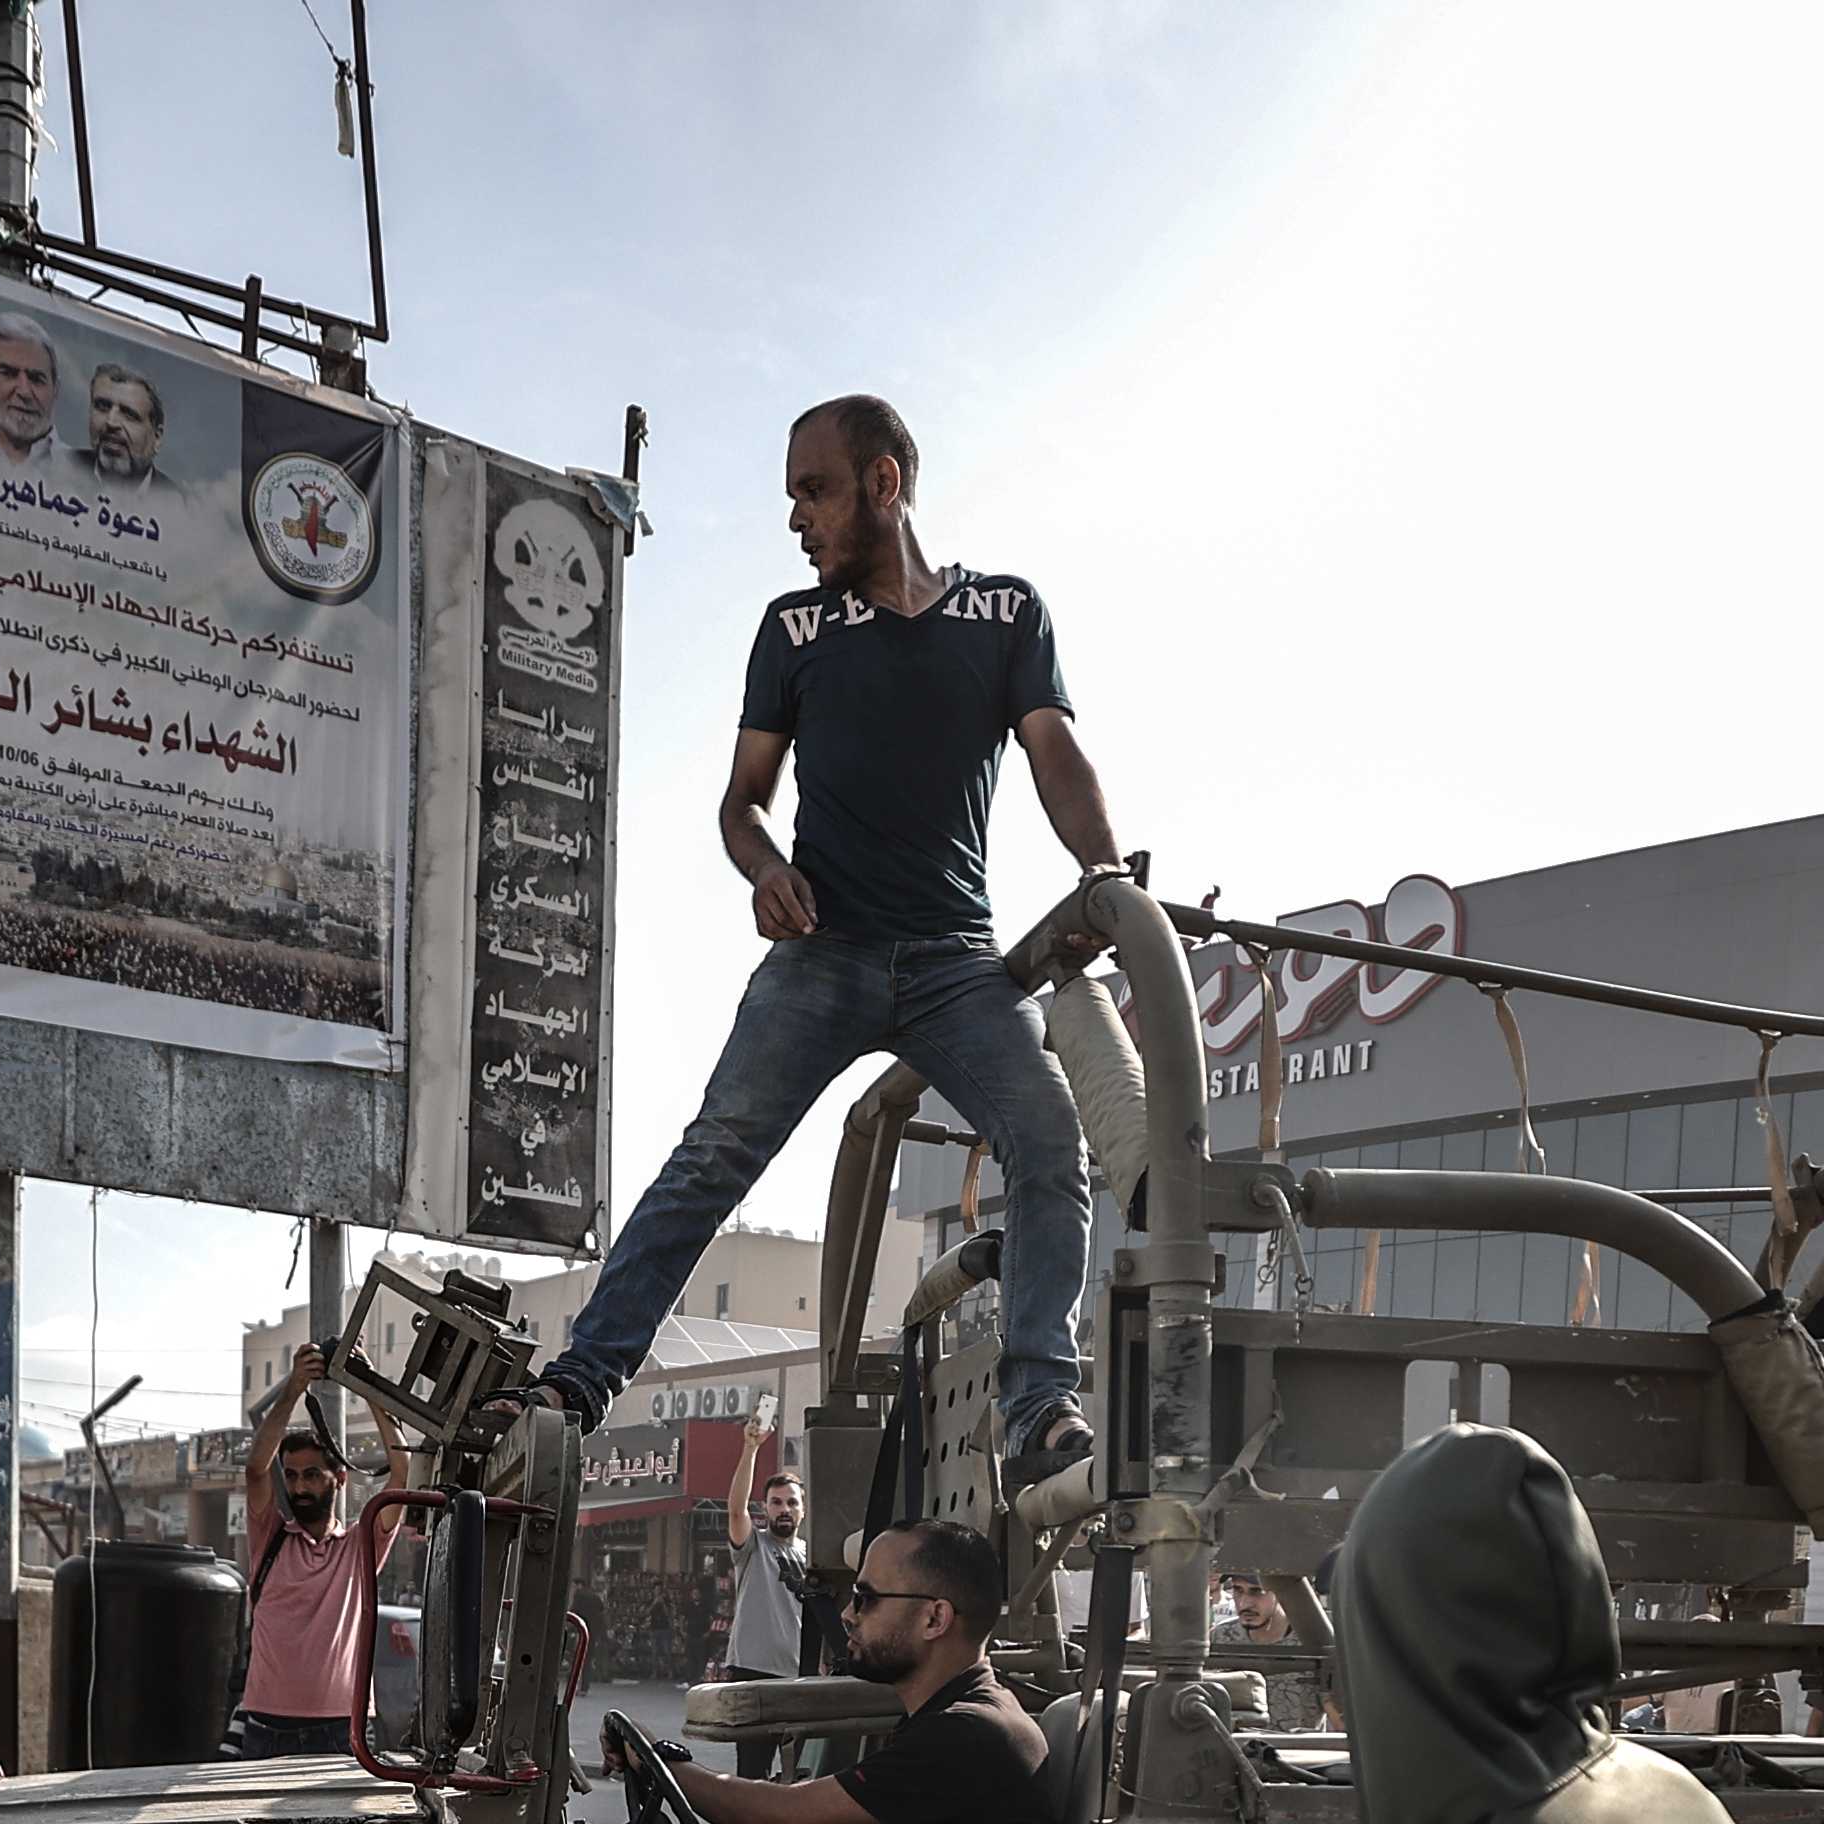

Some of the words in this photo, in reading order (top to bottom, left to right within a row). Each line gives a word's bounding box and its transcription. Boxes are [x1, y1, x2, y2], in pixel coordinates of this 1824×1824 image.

[96, 493, 160, 542] دعوة
[52, 536, 111, 565] المقاومة
[110, 553, 154, 577] شعب
[101, 591, 177, 628] الجهاد
[45, 634, 90, 655] ذكرى
[179, 609, 238, 647] حركة
[92, 640, 123, 664] في
[124, 652, 171, 676] الكبير
[241, 632, 355, 675] تستنفركم
[501, 648, 553, 677] Military
[555, 665, 595, 689] Media
[172, 665, 232, 693] الوطني
[233, 679, 307, 709] المهرجان
[39, 683, 153, 757] بشائر
[307, 697, 361, 723] لحضور
[496, 688, 596, 745] سرايا
[160, 708, 298, 777] الشهداء
[14, 775, 64, 798] الكتيبة
[492, 758, 596, 804] القدس
[65, 787, 97, 809] أرض
[97, 796, 129, 811] على
[128, 798, 178, 820] مباشرة
[54, 818, 98, 836] الجهاد
[100, 823, 149, 845] لمسيرة
[179, 810, 216, 829] العصر
[216, 816, 249, 837] صلاة
[251, 829, 275, 843] بعد
[492, 811, 592, 864] الجناح
[489, 873, 590, 920] العسكري
[488, 922, 589, 979] لحركة
[484, 988, 589, 1037] الجهاد
[481, 1051, 588, 1099] الإسلامي
[520, 1111, 547, 1158] في
[480, 1164, 583, 1208] فلسطين
[654, 1436, 680, 1485] أبو
